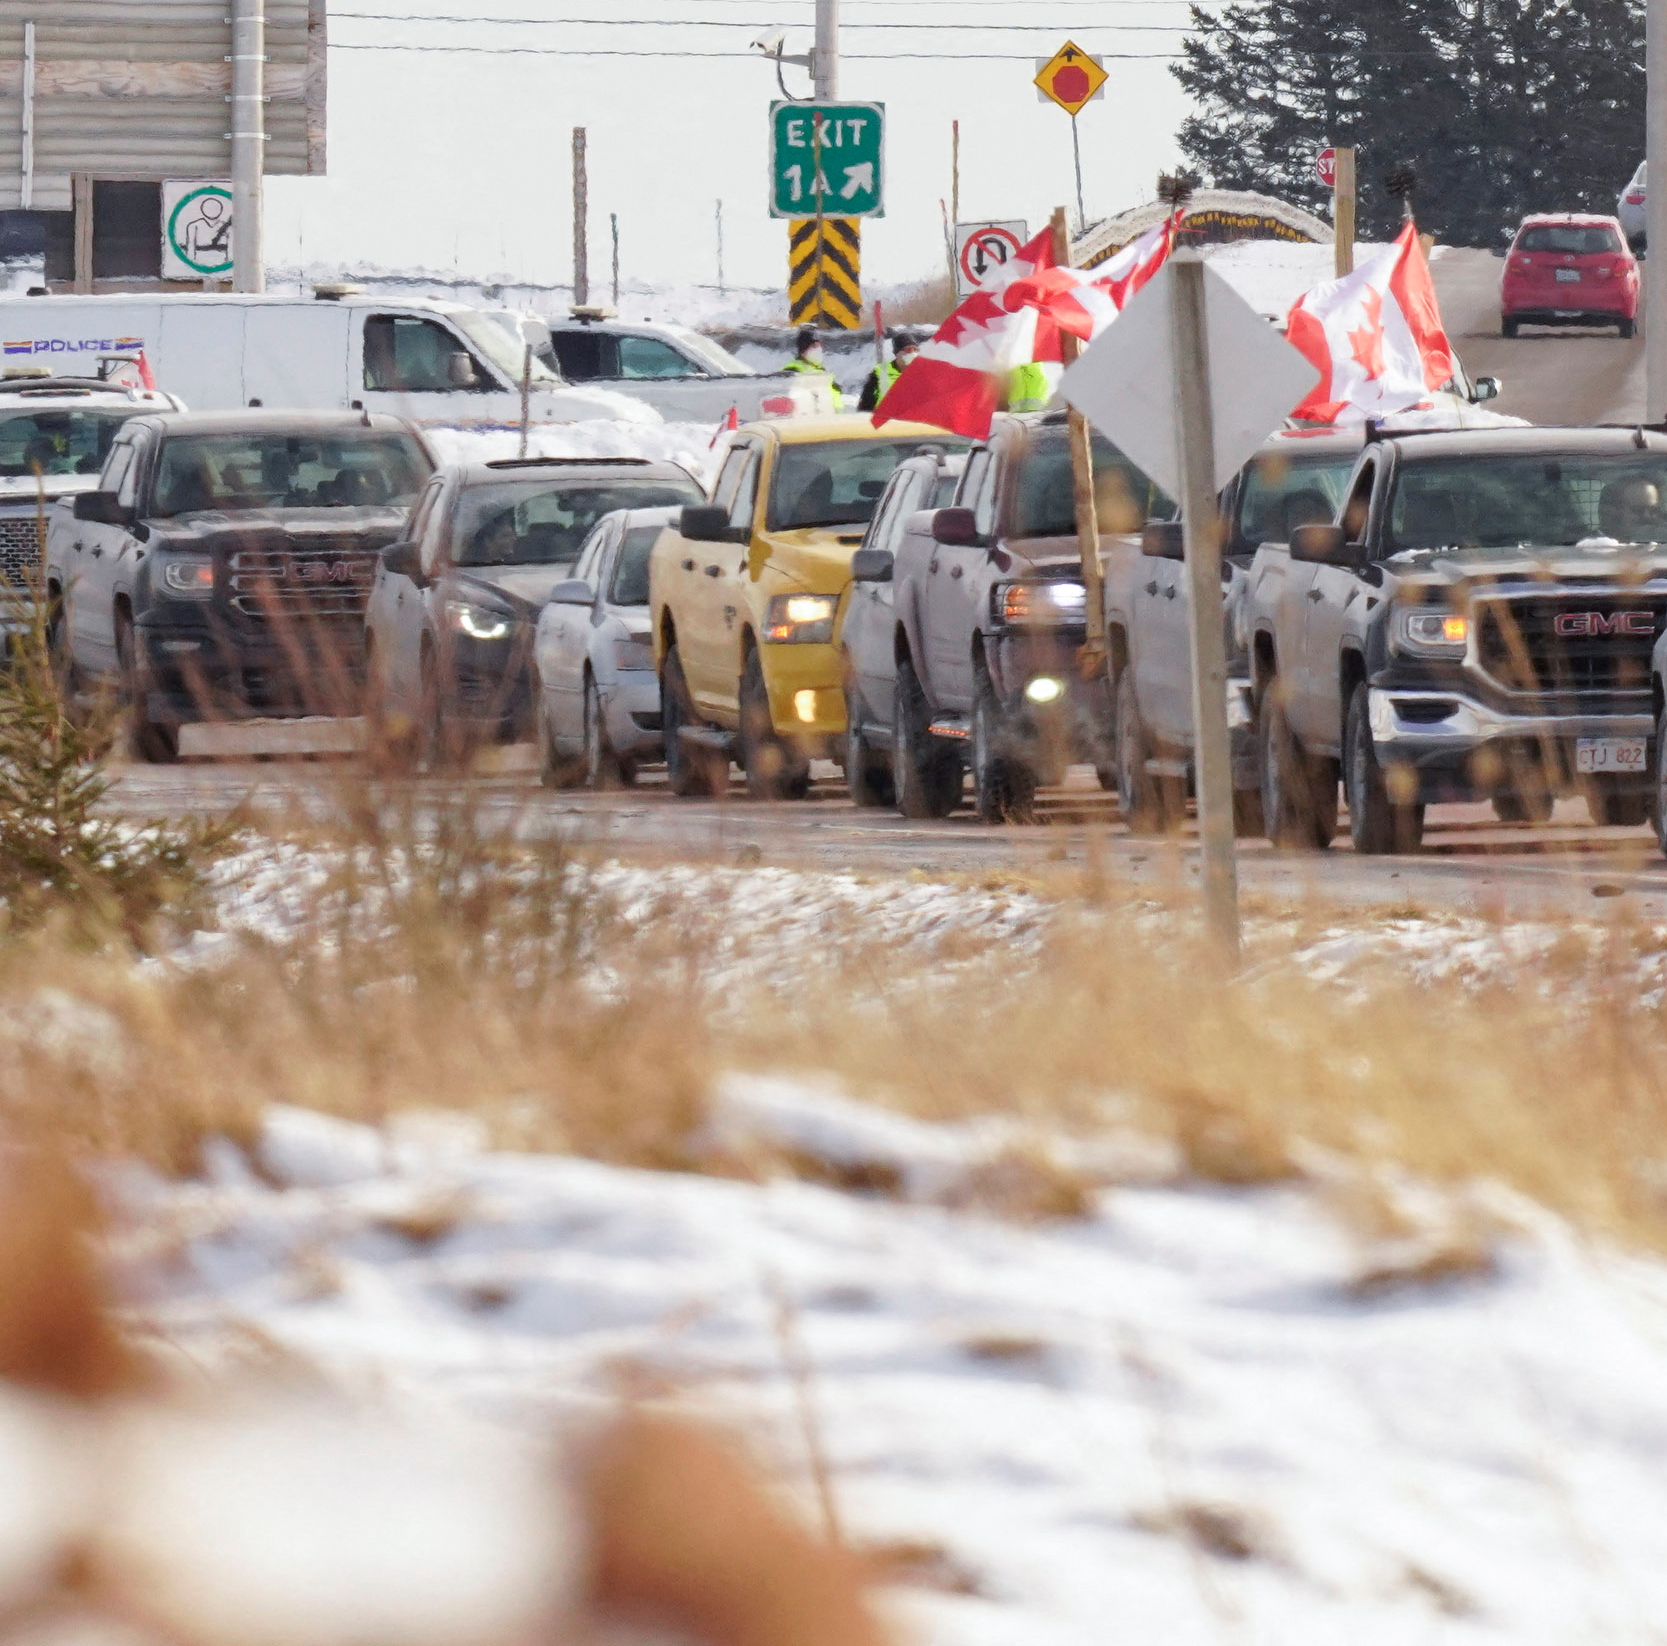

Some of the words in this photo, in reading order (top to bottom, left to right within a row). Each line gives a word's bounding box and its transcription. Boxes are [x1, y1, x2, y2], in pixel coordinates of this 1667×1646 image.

[786, 119, 867, 147] EXIT
[783, 164, 833, 201] 1A
[34, 339, 113, 353] POLICE
[289, 560, 372, 582] GMC
[1554, 611, 1655, 635] GMC
